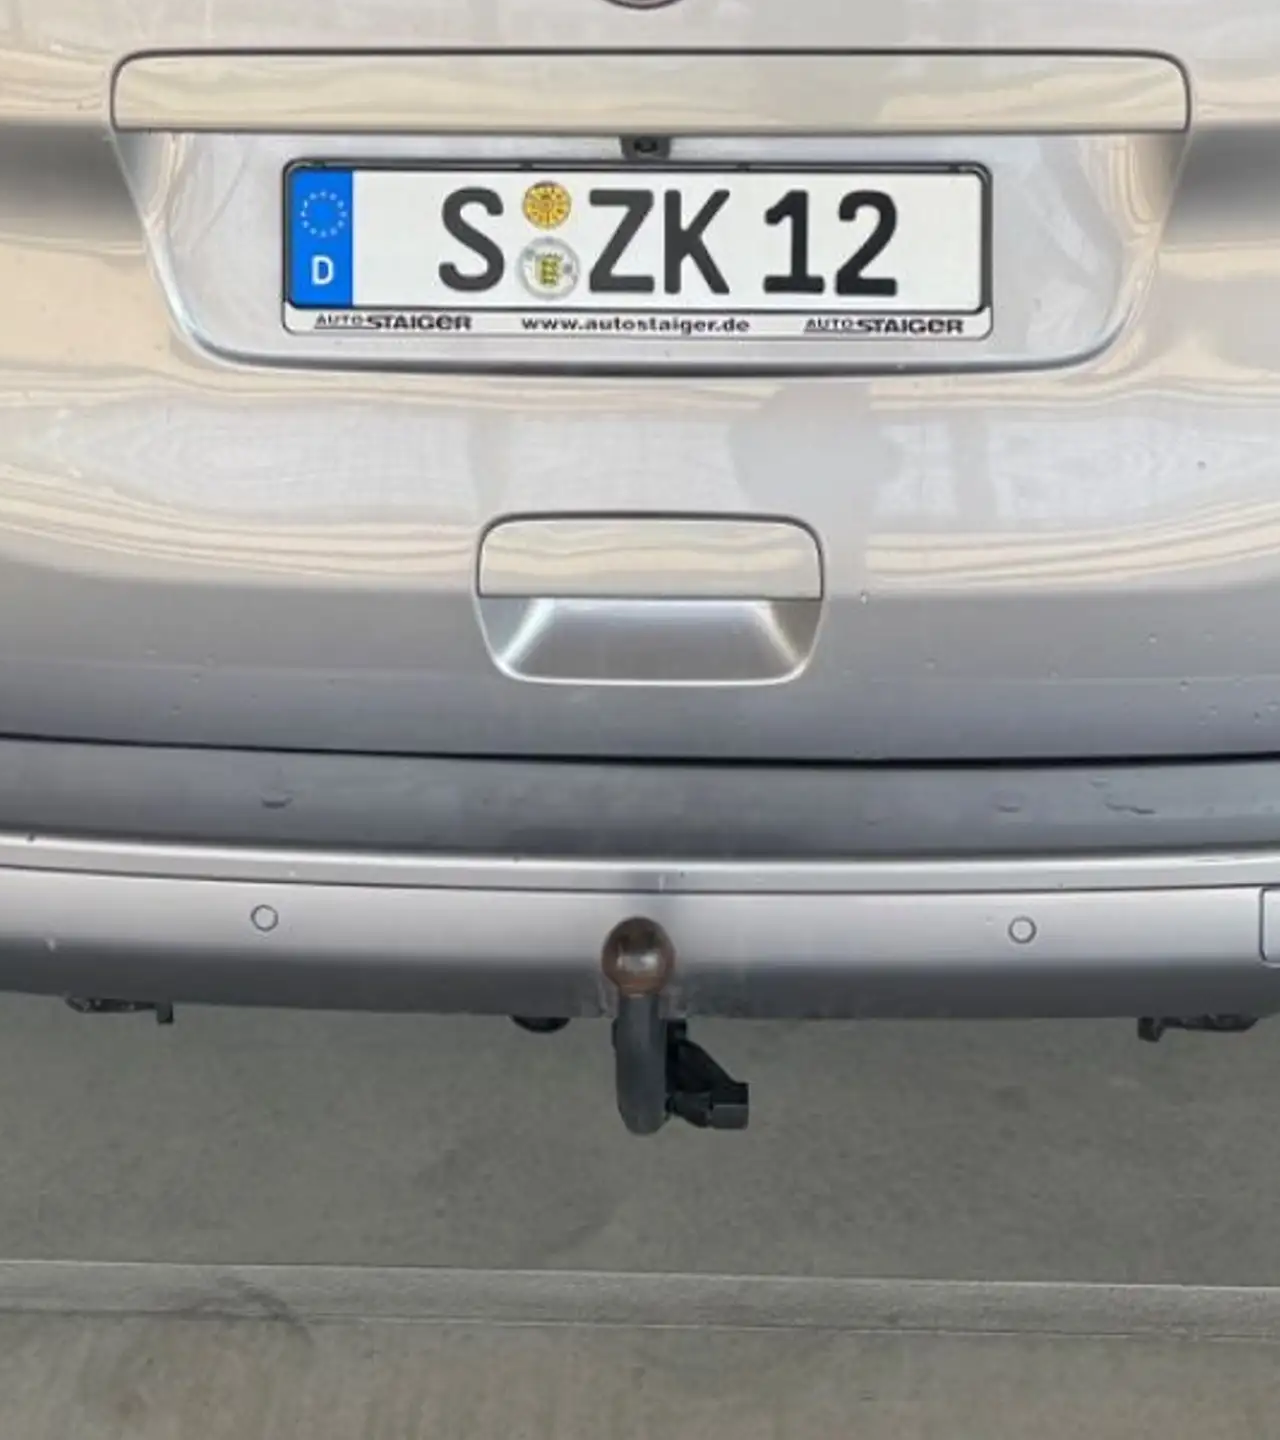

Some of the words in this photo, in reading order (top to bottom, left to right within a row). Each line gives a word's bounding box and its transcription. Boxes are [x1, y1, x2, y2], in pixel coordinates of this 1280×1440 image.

[438, 187, 505, 292] S
[312, 255, 334, 285] D
[520, 316, 750, 335] www.autostaiger.de
